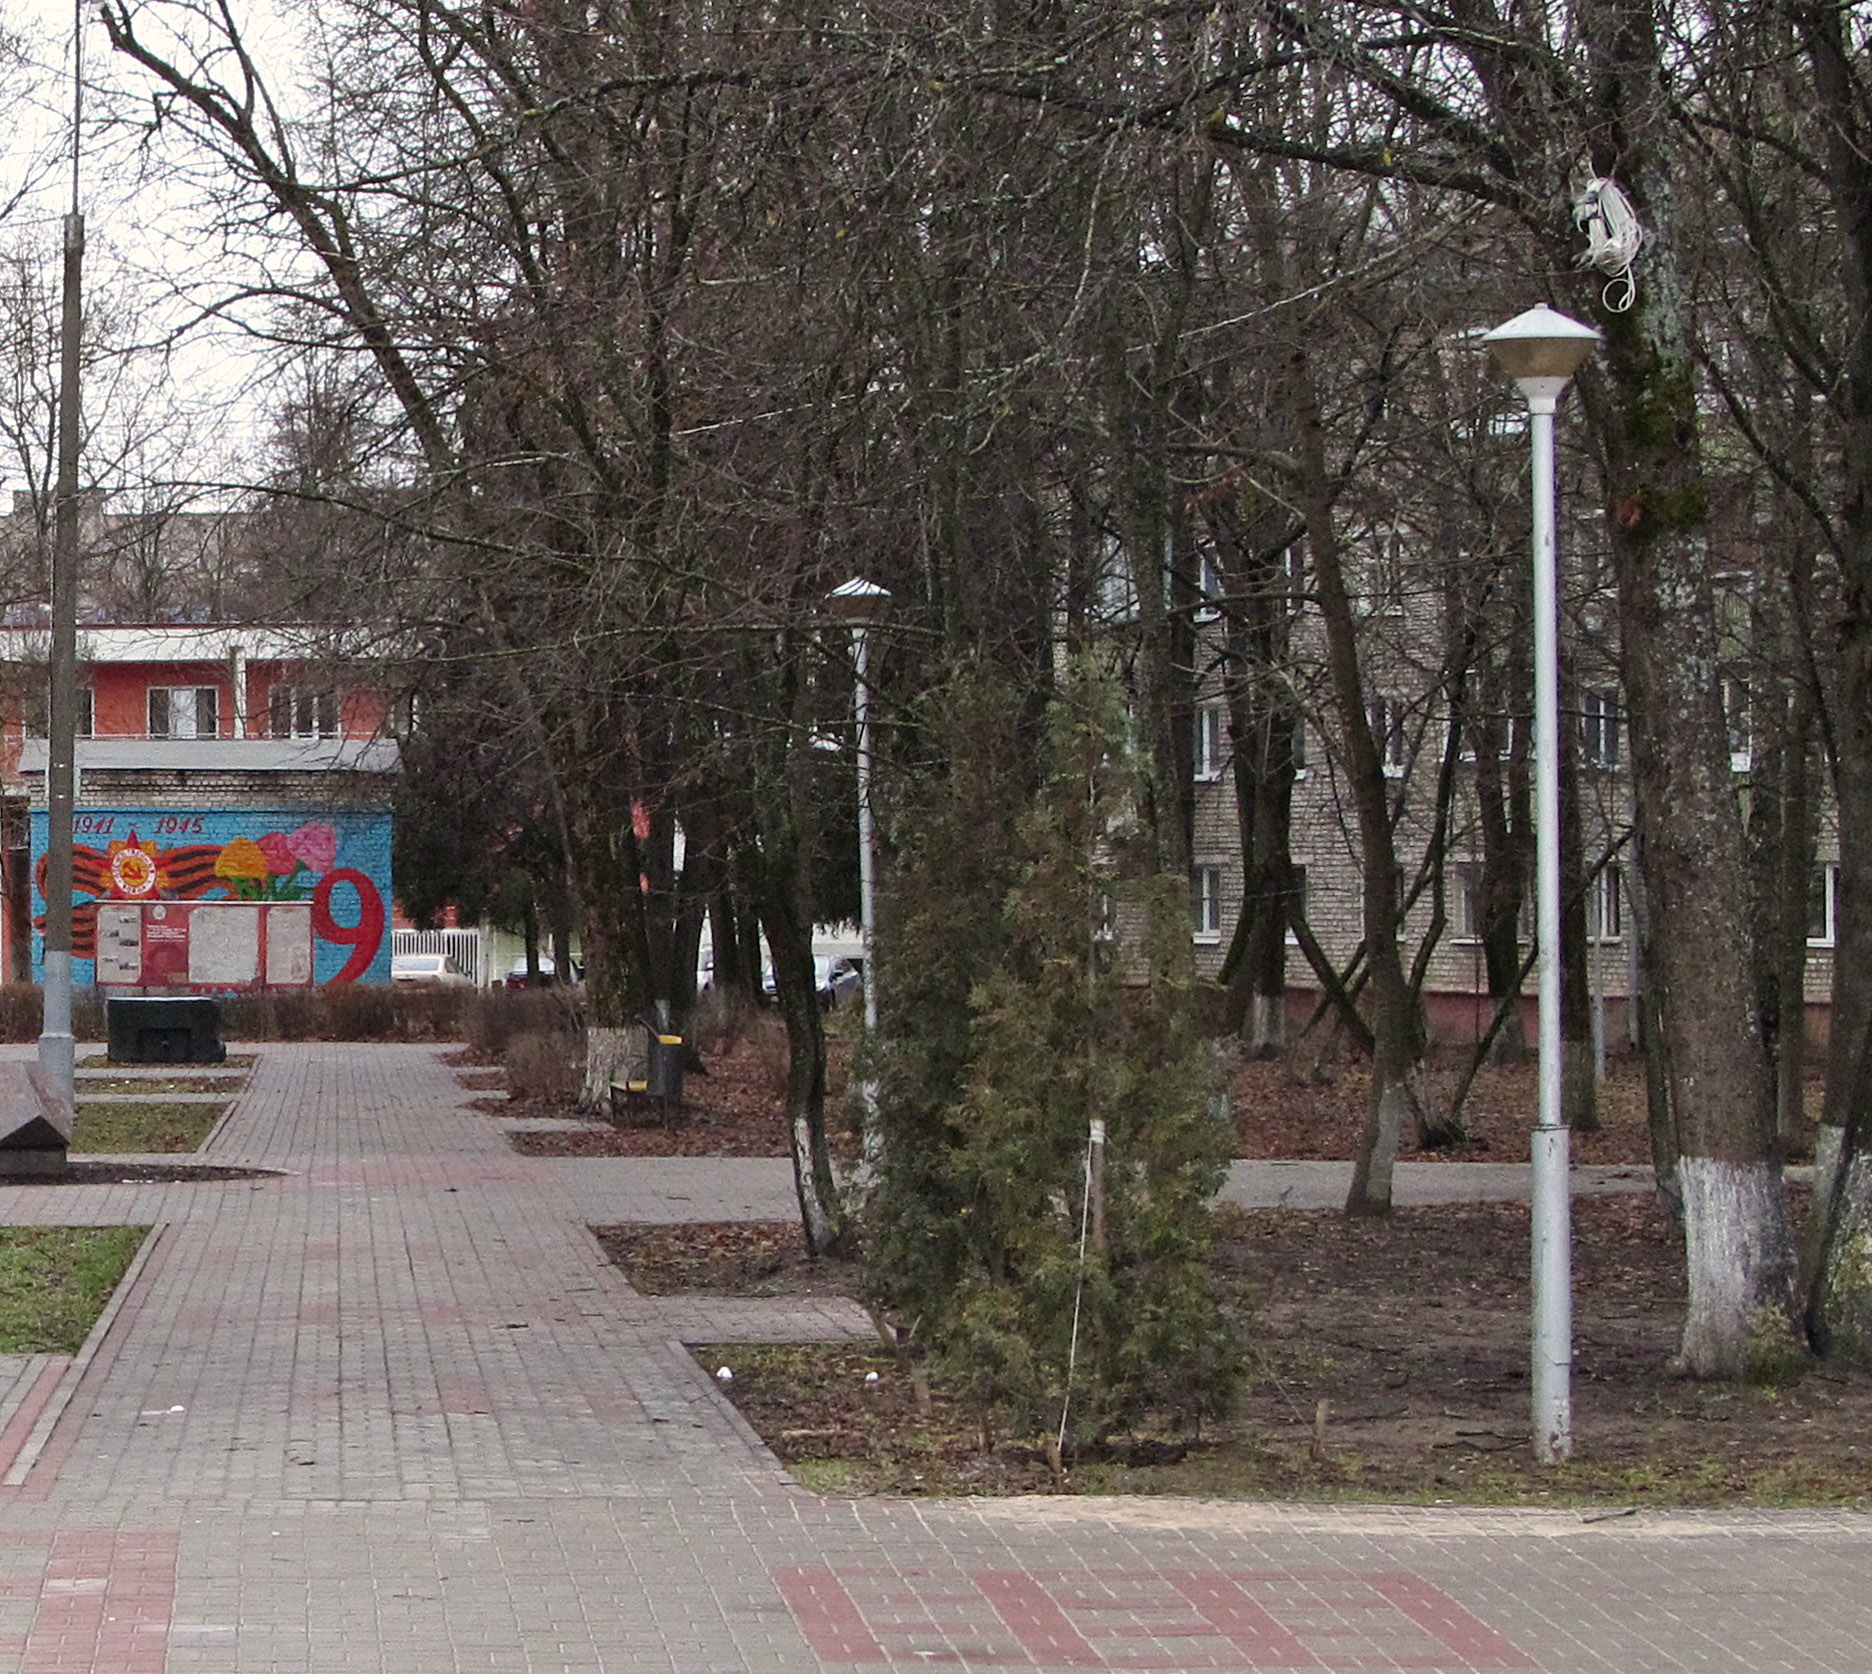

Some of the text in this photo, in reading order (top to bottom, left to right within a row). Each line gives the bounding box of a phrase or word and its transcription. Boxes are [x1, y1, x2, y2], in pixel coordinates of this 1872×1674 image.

[73, 816, 115, 834] 1941
[153, 816, 205, 834] 1945
[314, 867, 385, 987] 9
